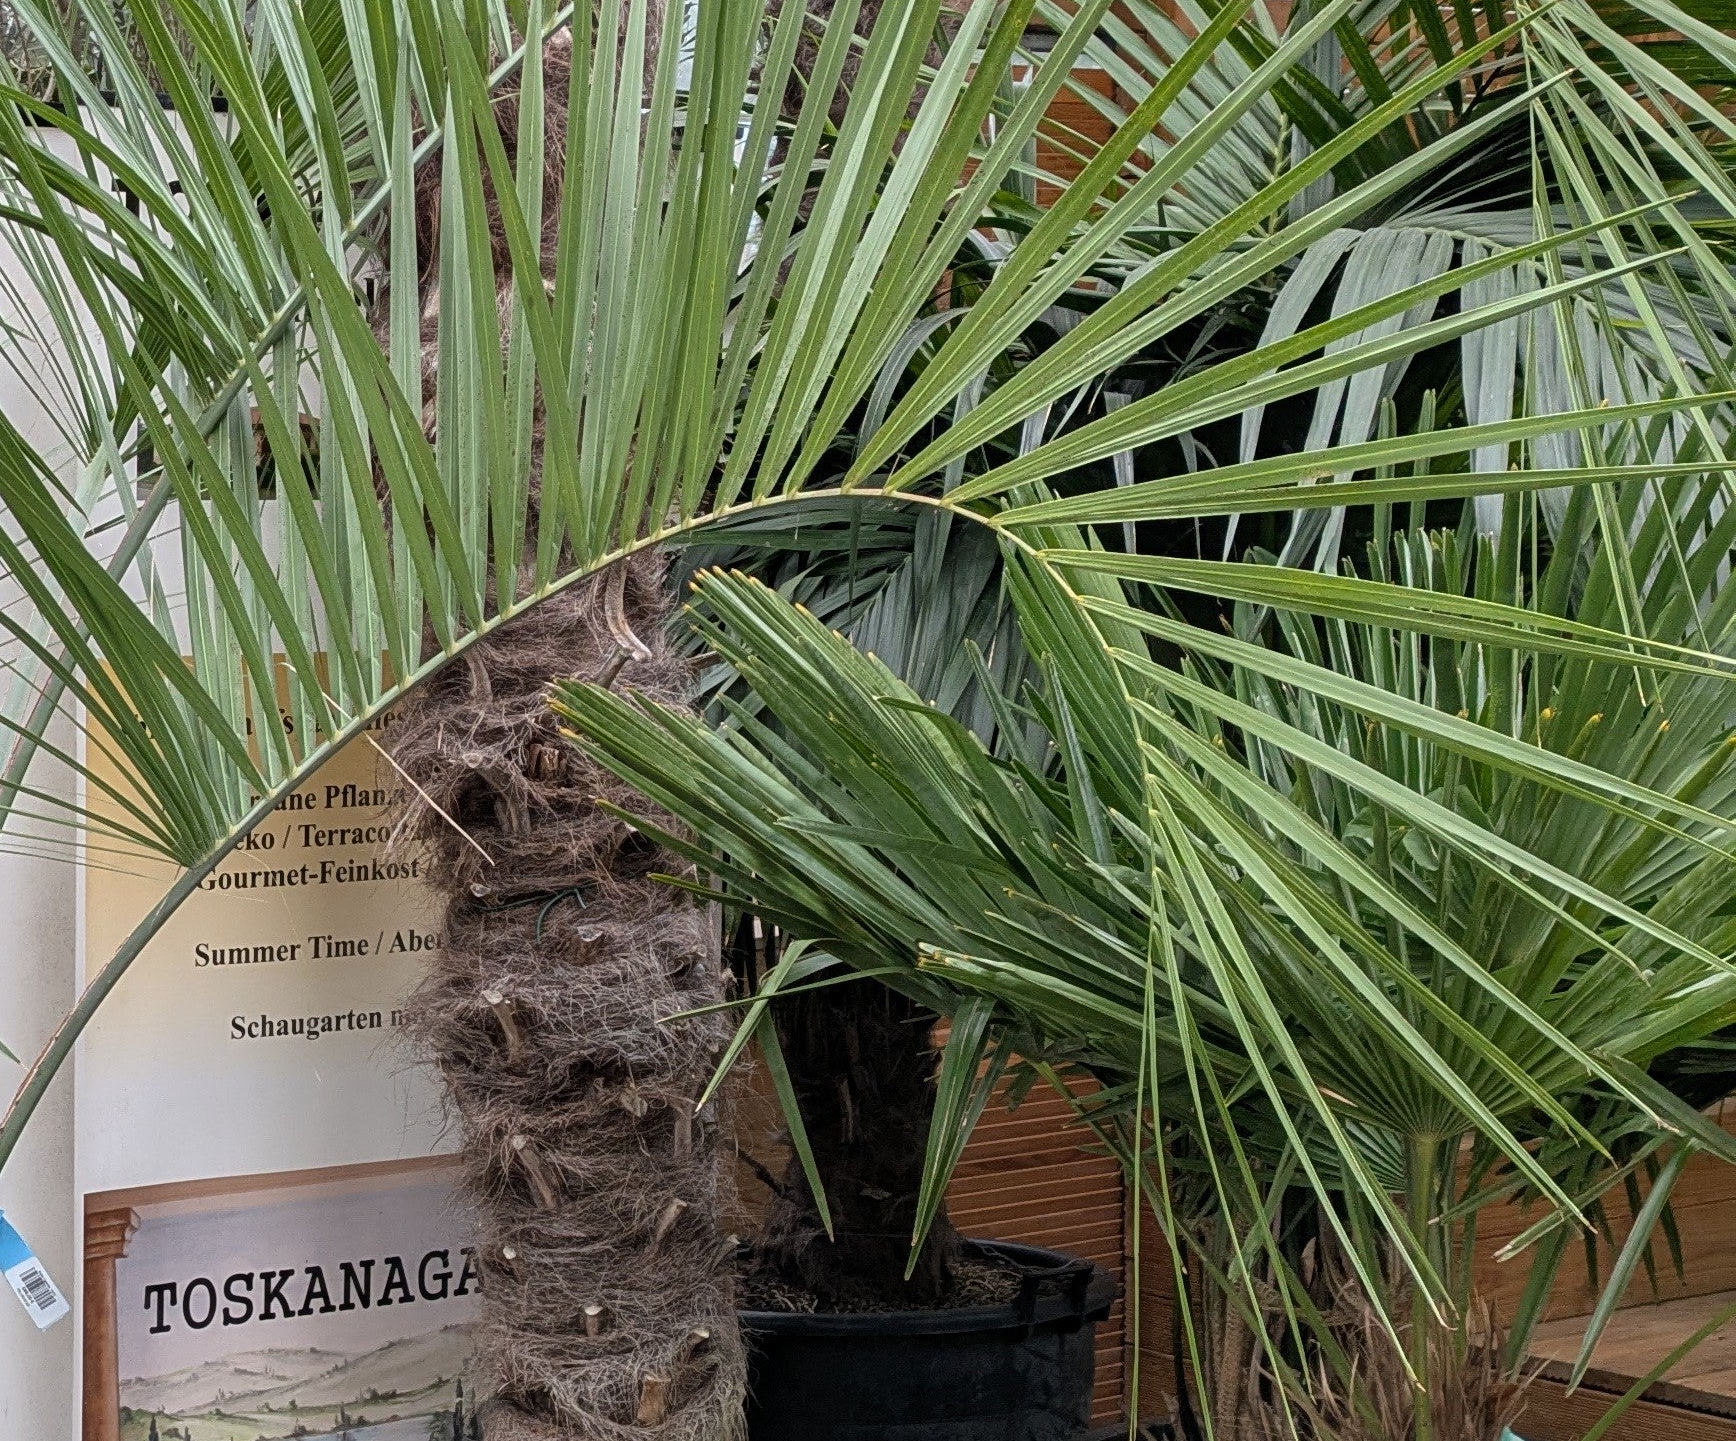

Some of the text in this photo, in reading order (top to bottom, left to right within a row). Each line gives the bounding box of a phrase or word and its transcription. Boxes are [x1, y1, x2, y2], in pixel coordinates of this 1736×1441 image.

[194, 942, 302, 968] Summer
[308, 934, 369, 960] Time
[230, 1008, 383, 1041] Schaugarten
